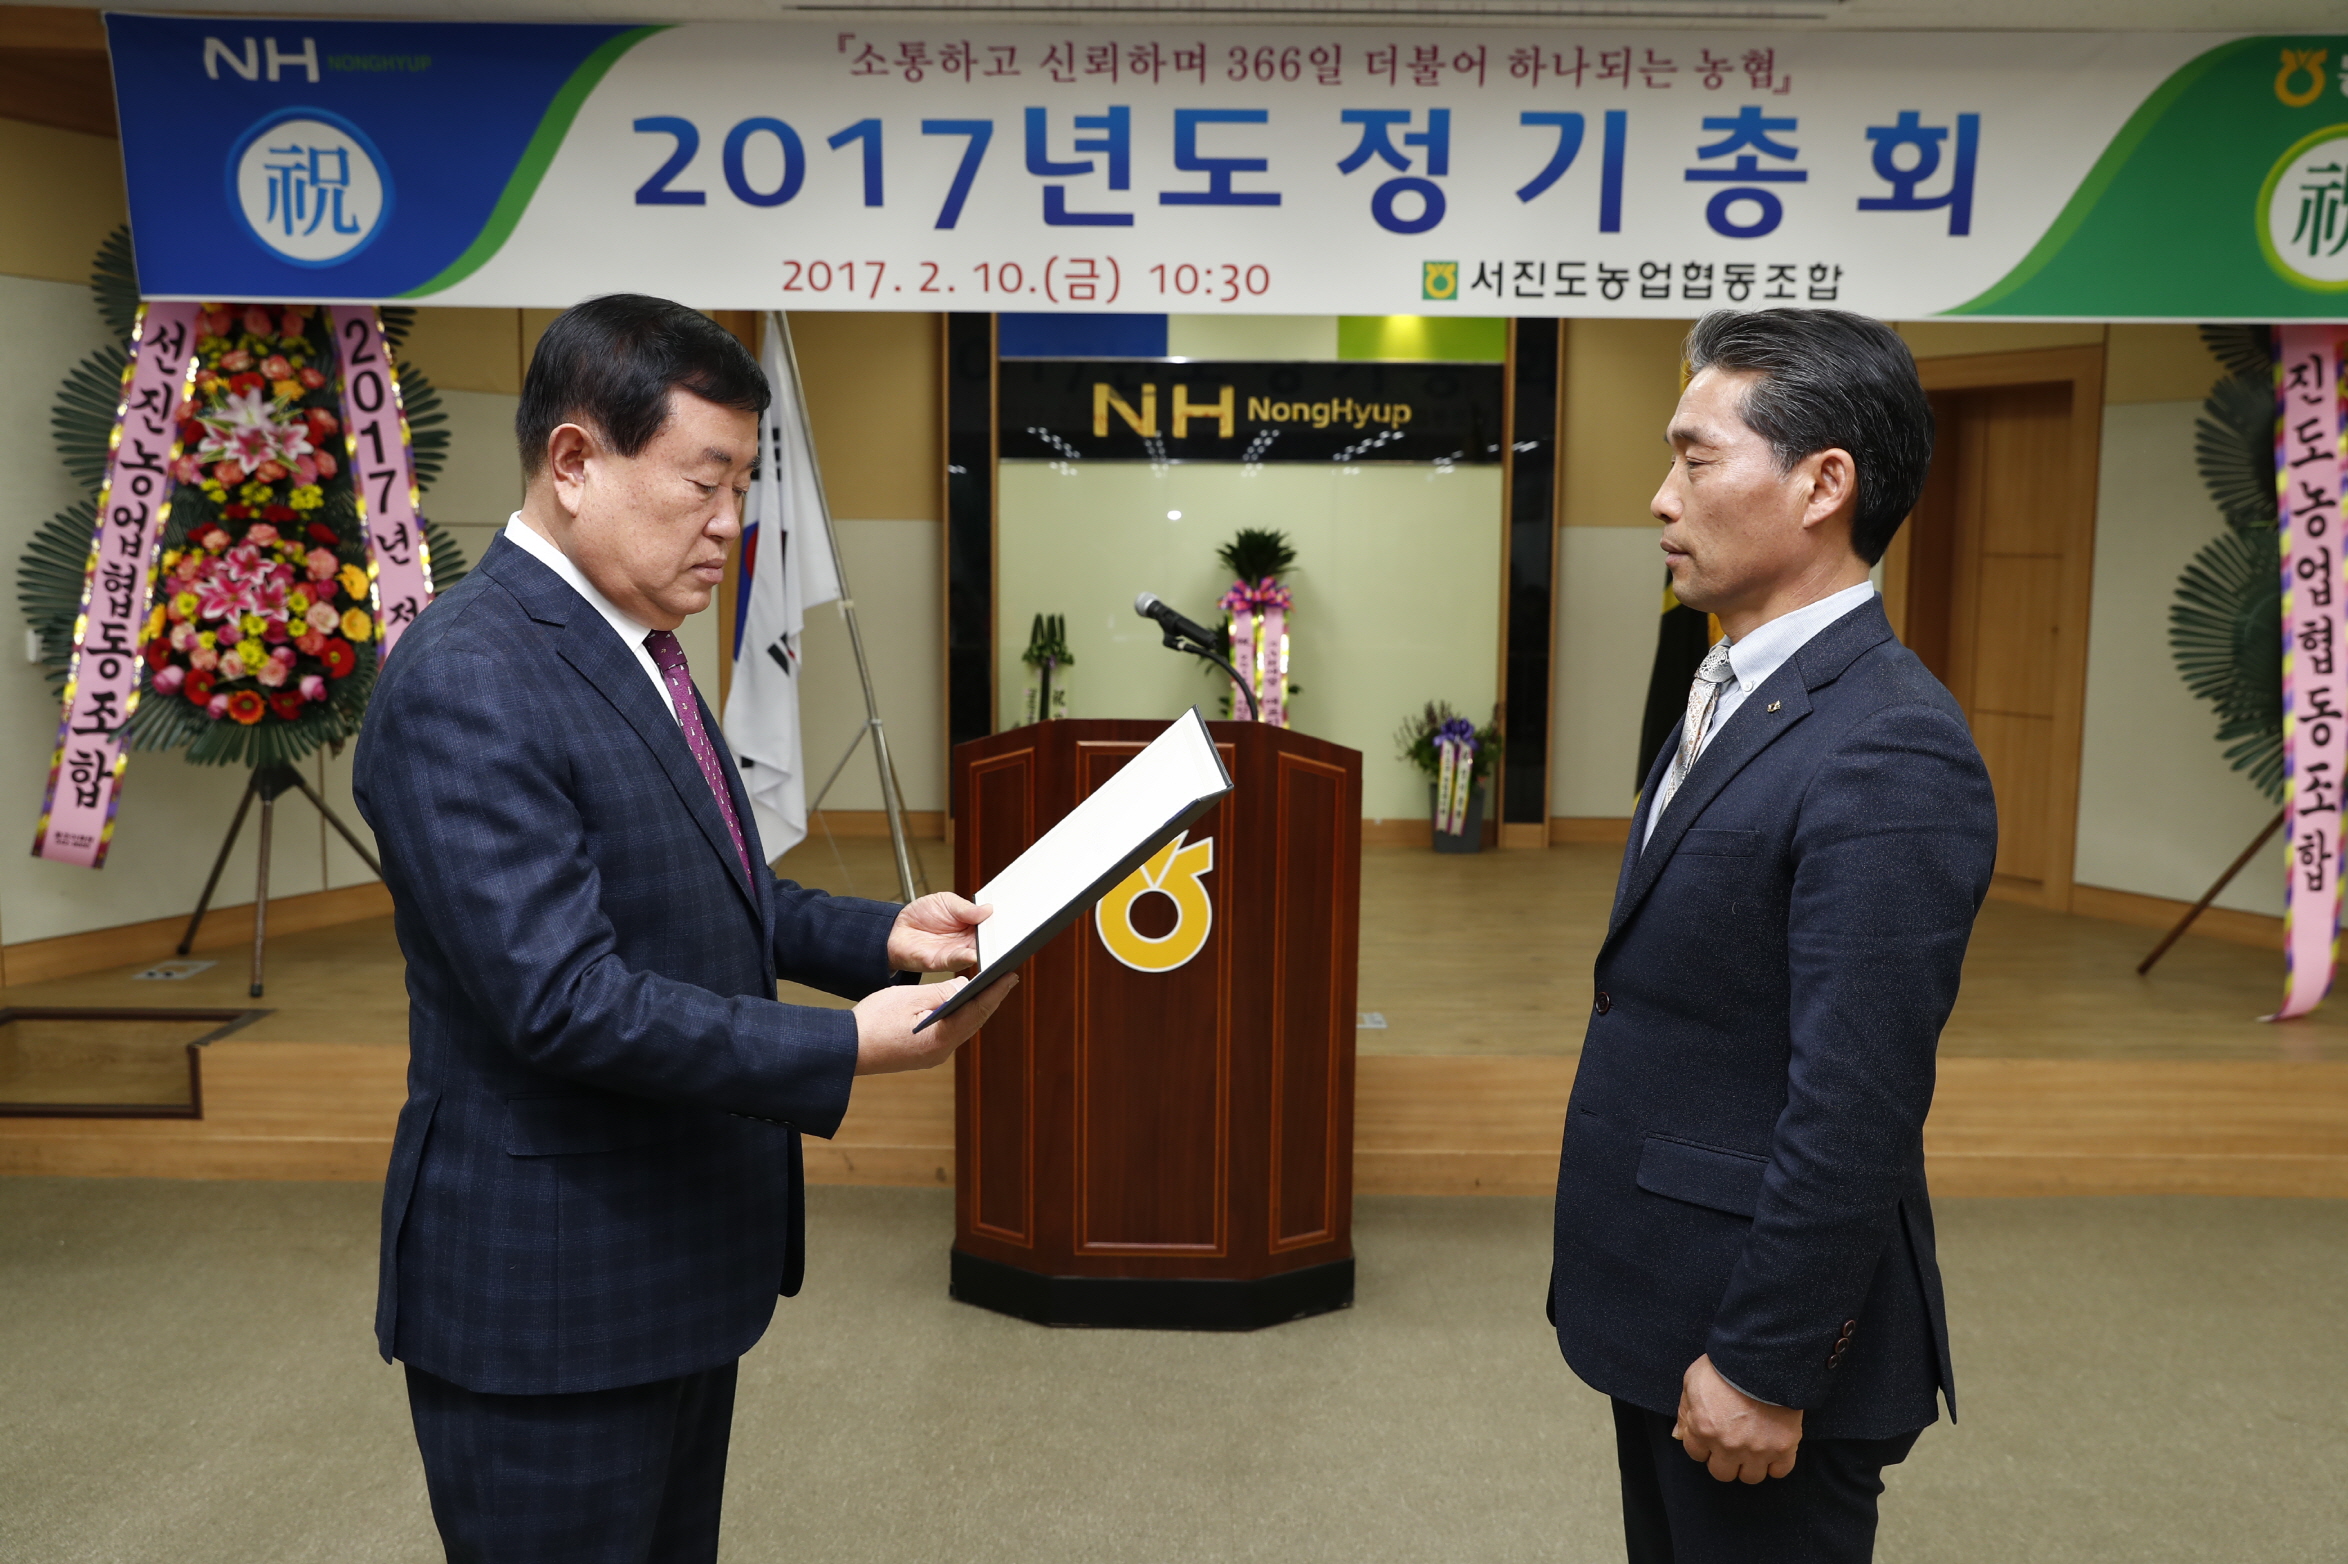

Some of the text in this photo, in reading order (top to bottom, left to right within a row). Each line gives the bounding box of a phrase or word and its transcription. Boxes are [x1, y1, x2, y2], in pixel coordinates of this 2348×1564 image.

[203, 36, 433, 83] NH NONGHYUP
[1038, 41, 1209, 86] 신뢰하며
[1226, 43, 1344, 87] 366일
[1365, 43, 1488, 88] 더불어
[1507, 45, 1678, 90] 하나되는
[262, 143, 361, 237] 祝
[632, 104, 1283, 231] 2017년도
[781, 260, 902, 300] 2017.
[1149, 262, 1271, 304] 10:30
[1469, 259, 1845, 303] 서진도농업협동조합
[344, 317, 411, 566] 2017년
[1092, 382, 1413, 439] NH NongHyup
[68, 319, 187, 810] 선진농업협동조합
[2286, 353, 2343, 893] 진도농업협동조합
